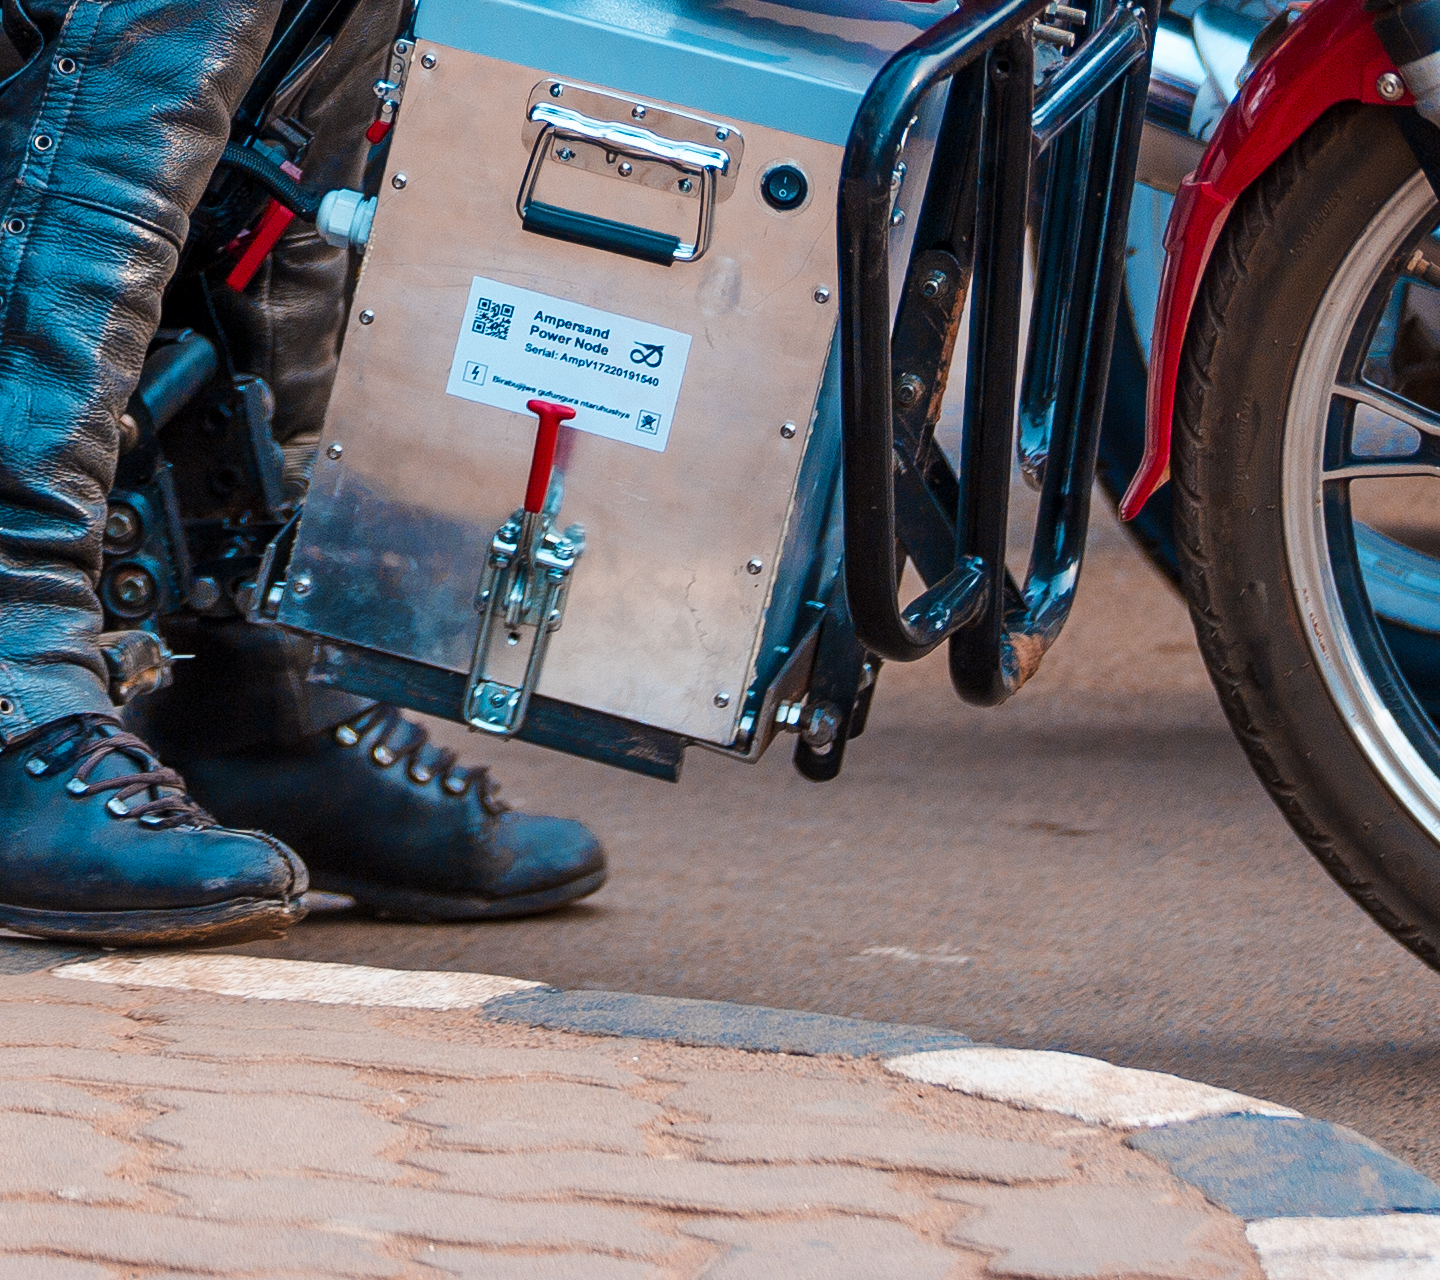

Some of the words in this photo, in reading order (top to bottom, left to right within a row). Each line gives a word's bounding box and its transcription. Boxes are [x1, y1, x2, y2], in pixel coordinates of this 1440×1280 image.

[529, 324, 573, 346] Power
[574, 336, 609, 356] Node
[533, 310, 610, 340] Ampersand
[524, 342, 559, 360] Serial:
